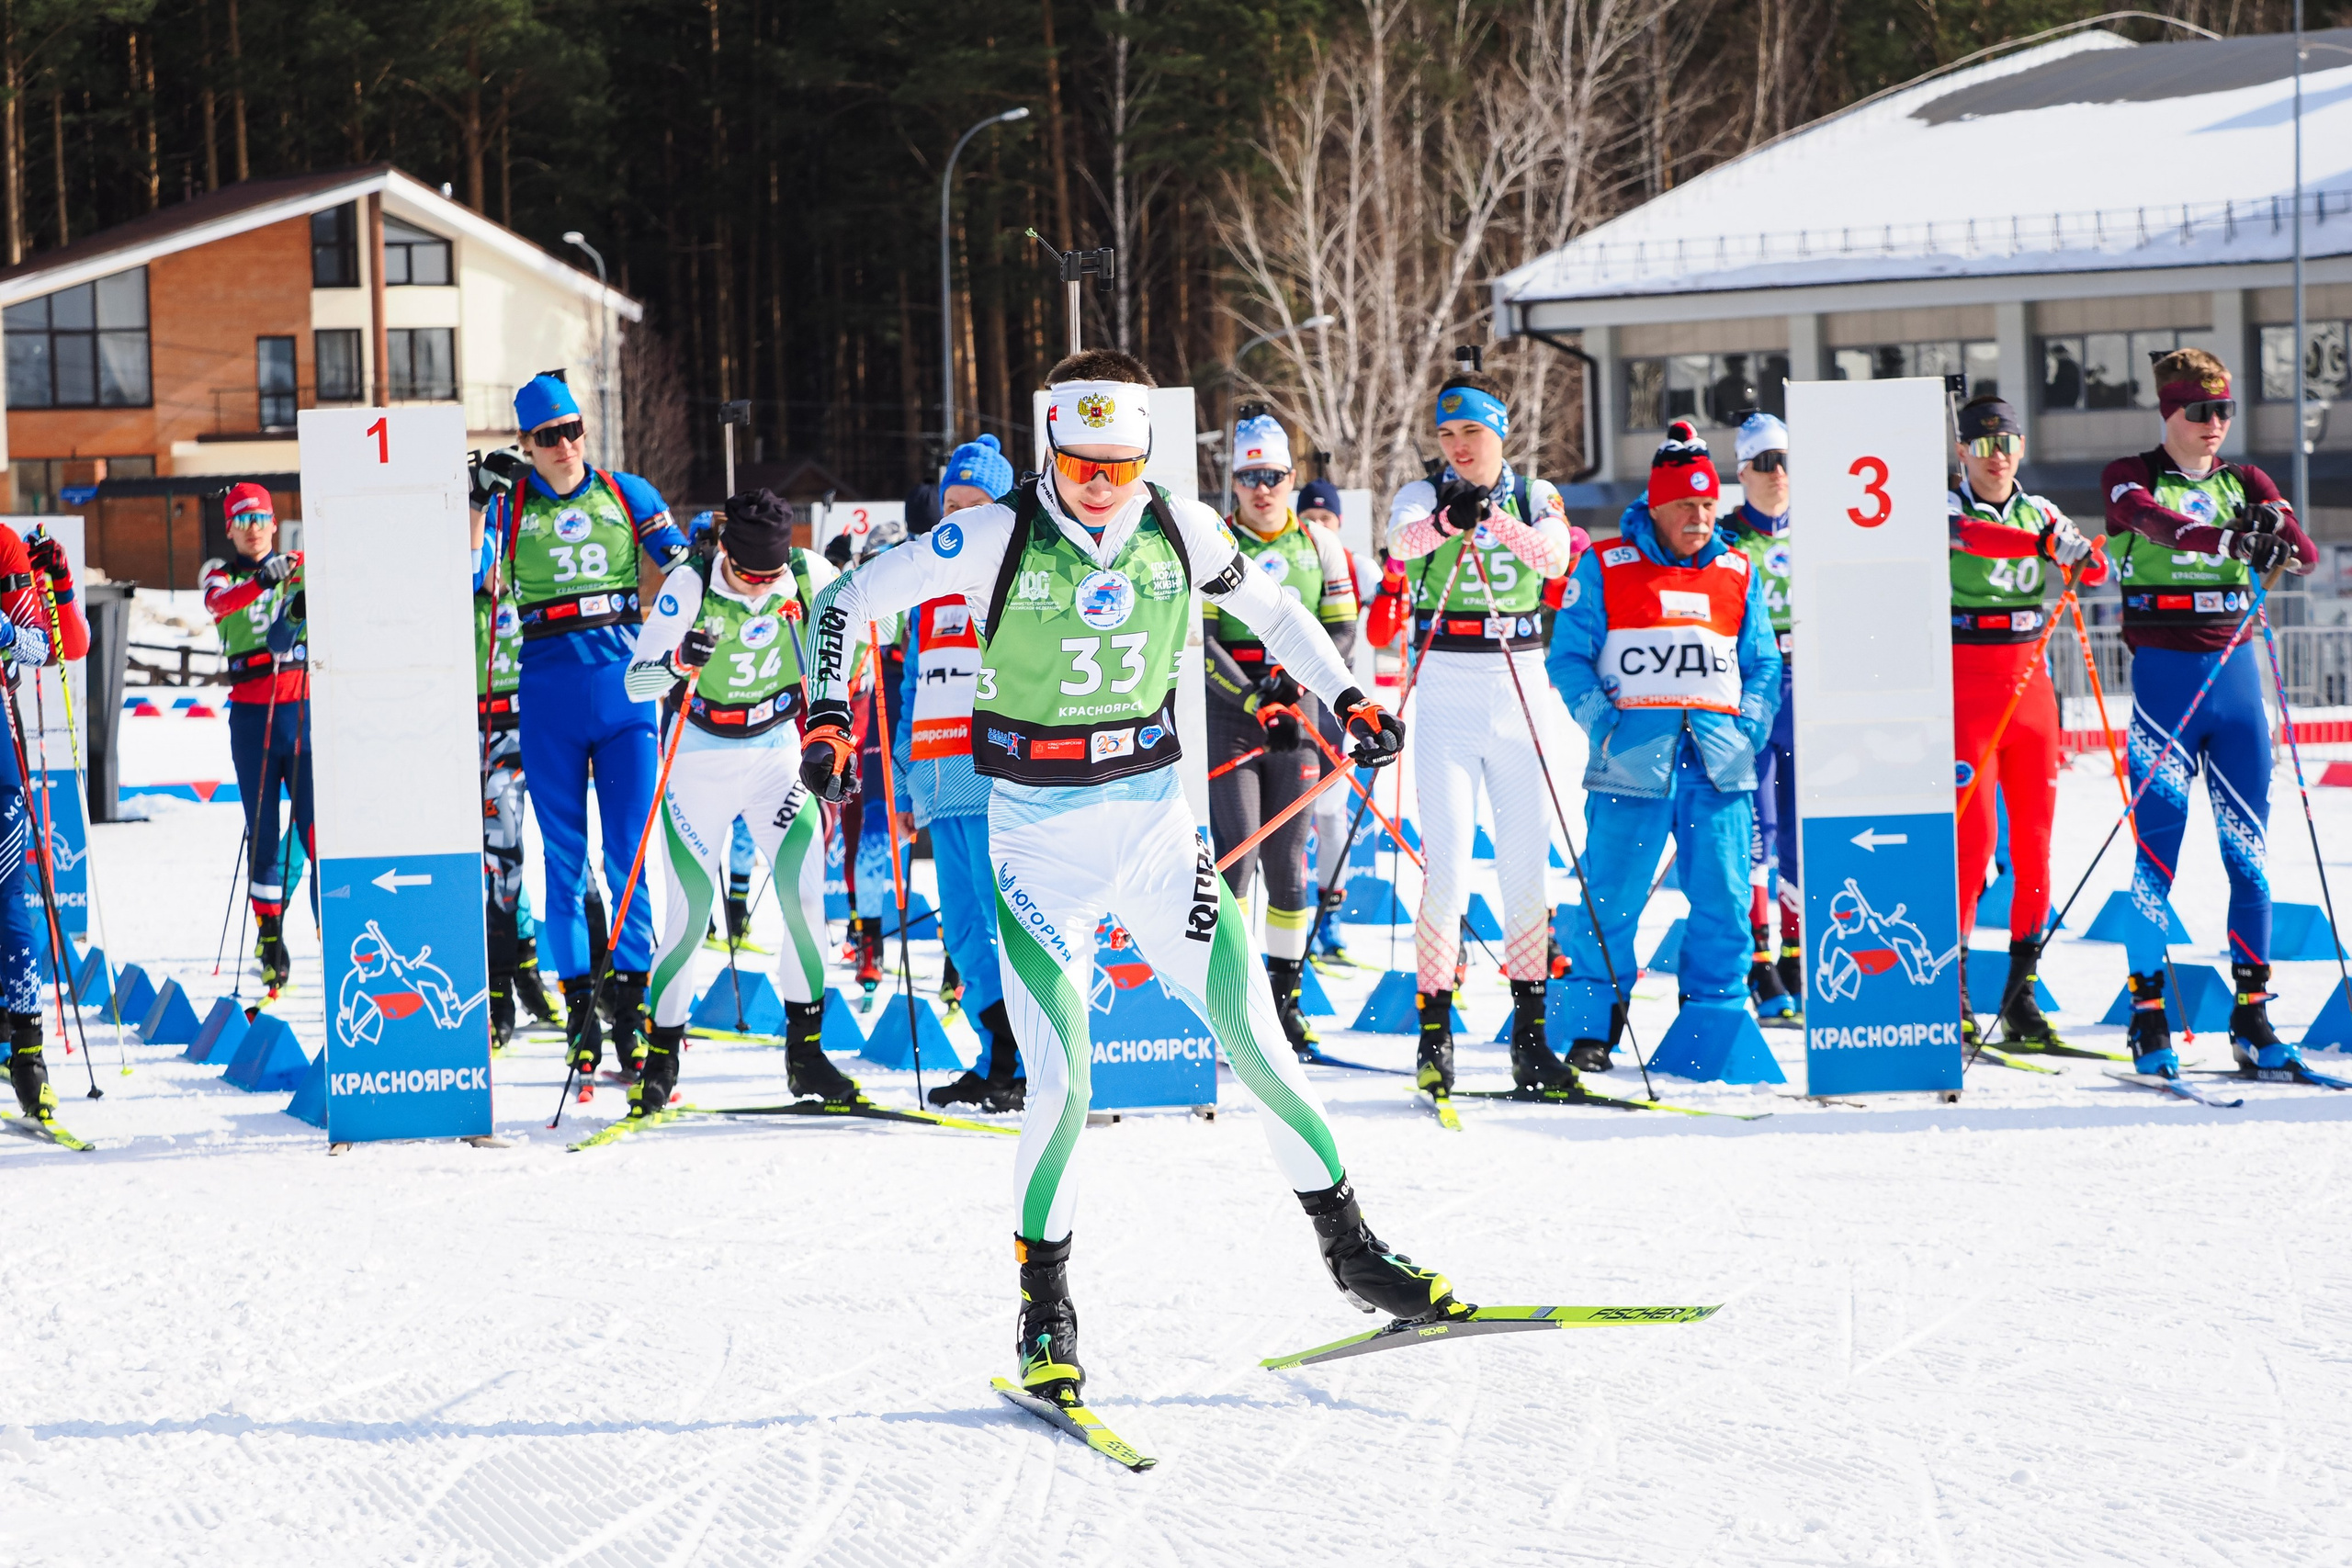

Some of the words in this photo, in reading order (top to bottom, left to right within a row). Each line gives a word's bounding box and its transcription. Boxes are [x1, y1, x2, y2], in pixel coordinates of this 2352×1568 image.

[367, 416, 389, 463] 1
[1847, 456, 1893, 528] 3
[853, 508, 870, 536] 3
[548, 543, 609, 582] 38
[1460, 551, 1518, 592] 35
[1611, 550, 1633, 562] 35
[1989, 557, 2040, 593] 40
[1764, 579, 1792, 612] 4
[729, 647, 782, 687] 34
[1058, 630, 1149, 696] 33
[1058, 700, 1145, 716] КРАСНОЯРСК
[912, 724, 968, 745] ноярский
[672, 803, 709, 857] ЮГОРИЯ
[1007, 899, 1049, 949] СТРАХОВАНИЕ
[1012, 889, 1072, 962] ЮГОРИЯ
[1091, 1037, 1213, 1064] АСНОЯРСК
[1810, 1022, 1959, 1050] КРАСНОЯРСК
[331, 1066, 488, 1096] КРАСНОЯРСК
[2257, 1069, 2294, 1082] SALOMON
[1588, 1308, 1687, 1320] FISCHER
[1418, 1325, 1449, 1337] FISCHER
